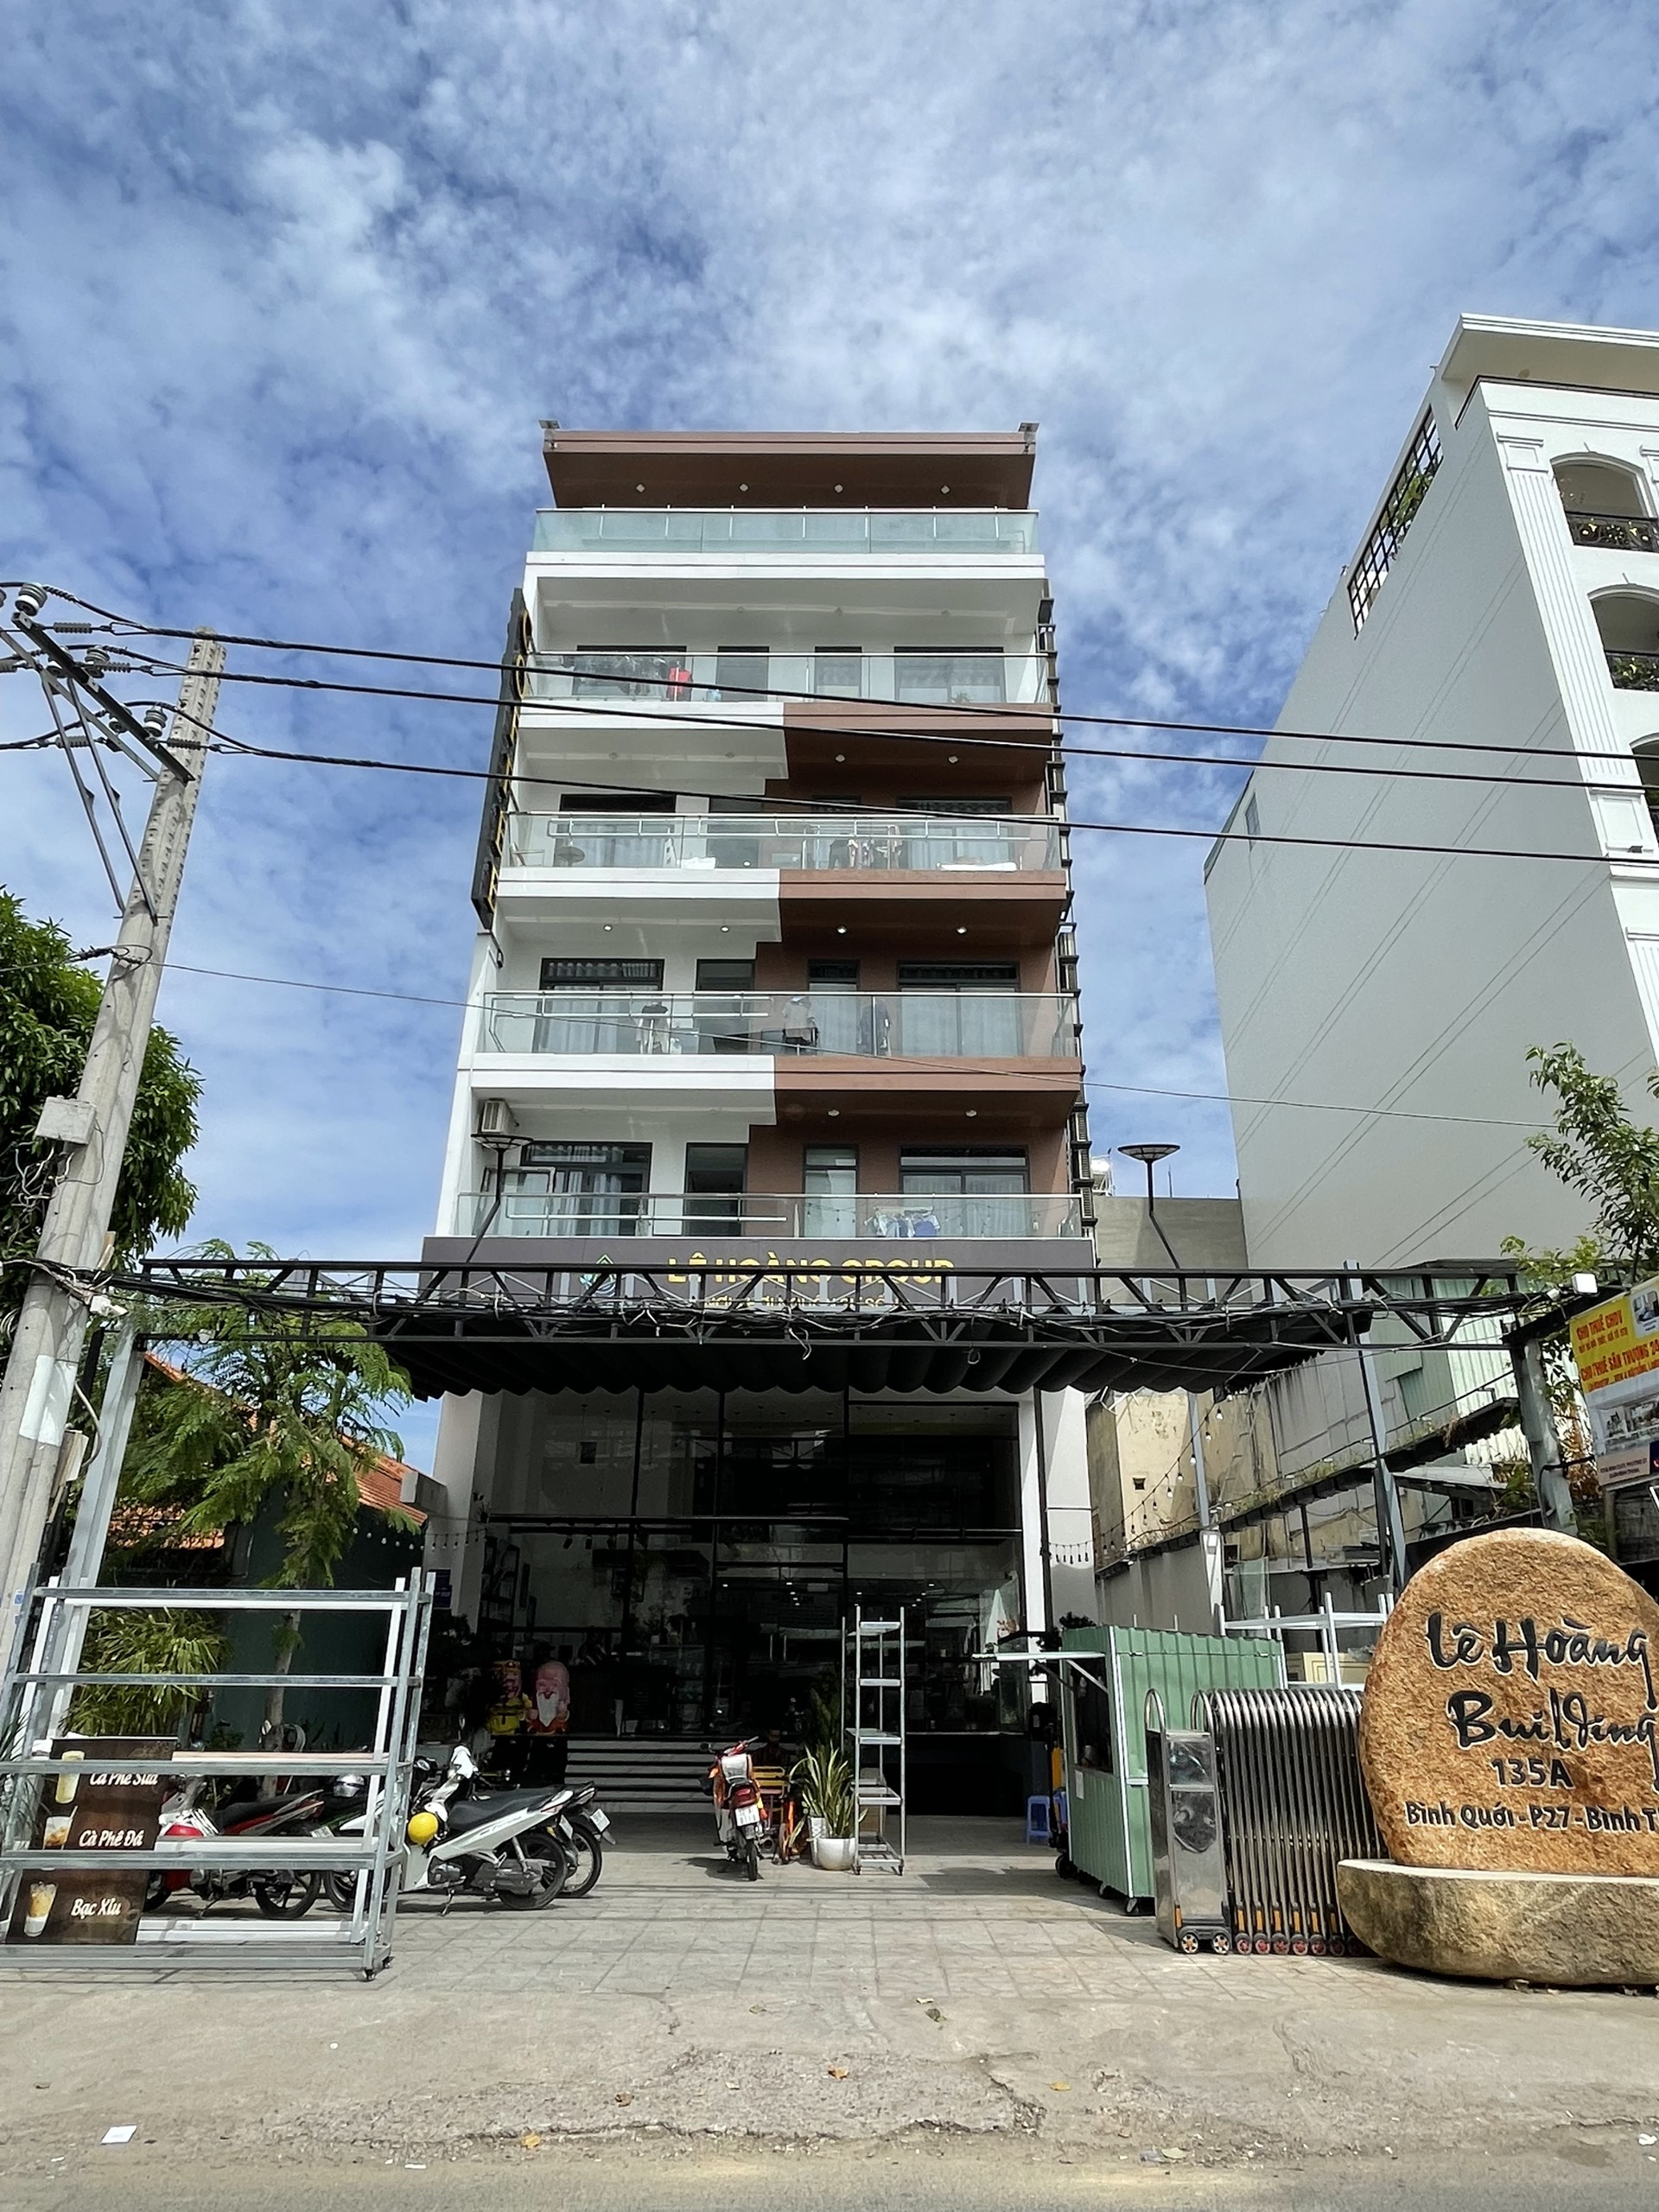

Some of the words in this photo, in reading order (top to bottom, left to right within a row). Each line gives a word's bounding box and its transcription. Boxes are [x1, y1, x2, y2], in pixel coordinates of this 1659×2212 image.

[1491, 1617, 1657, 1710] Hoàng
[1447, 1688, 1659, 1792] Building
[1491, 1758, 1573, 1789] 135A
[1405, 1801, 1456, 1826] Bình
[1529, 1804, 1570, 1828] P27
[1585, 1804, 1641, 1831] Bình
[79, 1830, 98, 1847] Cà
[98, 1829, 124, 1847] Phê
[124, 1829, 145, 1847] Đá
[71, 1897, 98, 1920] Bạc
